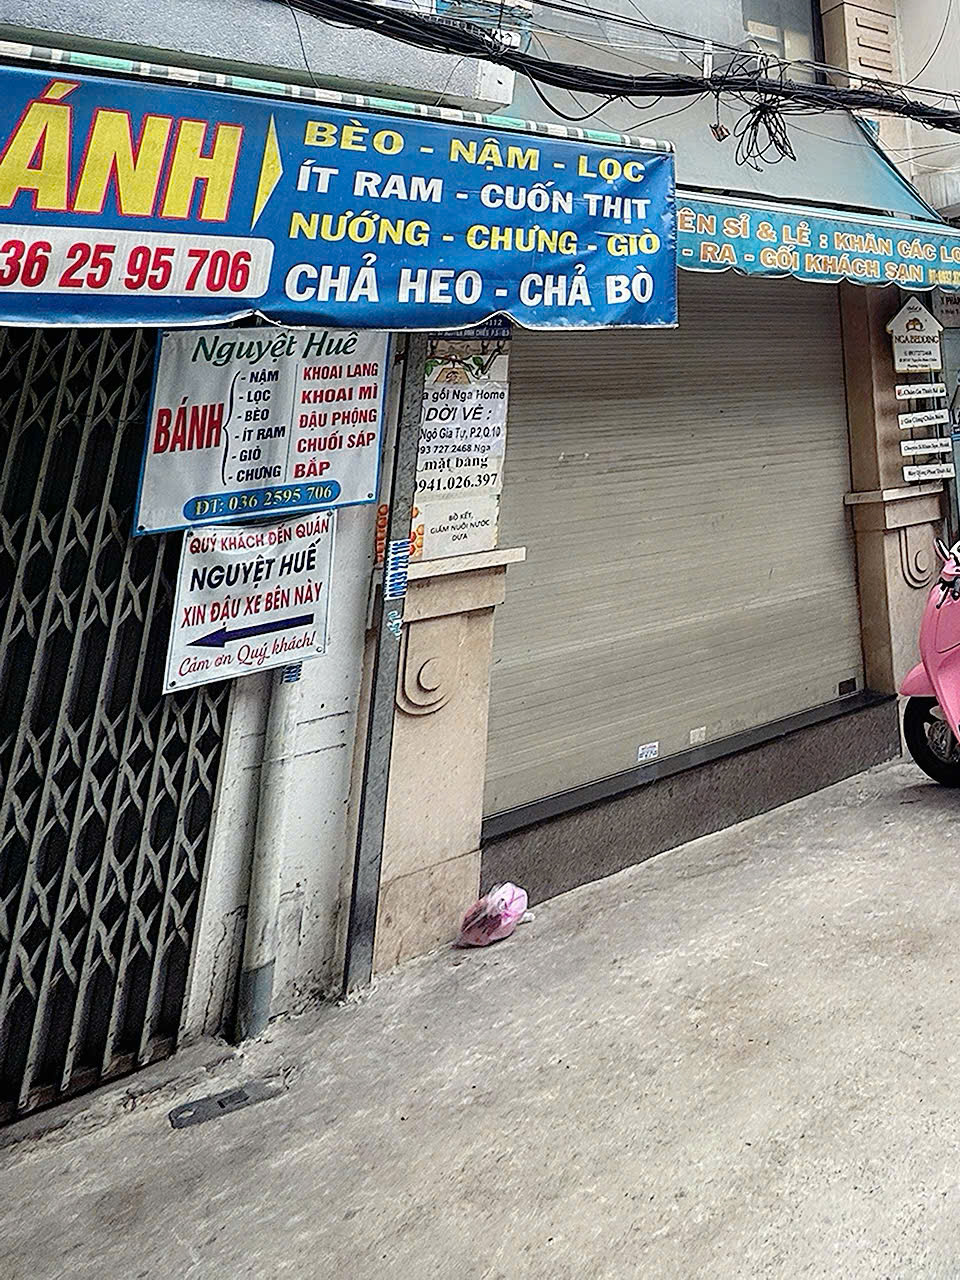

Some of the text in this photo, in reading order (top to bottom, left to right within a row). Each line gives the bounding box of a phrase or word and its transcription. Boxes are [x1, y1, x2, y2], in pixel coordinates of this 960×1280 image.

[0, 80, 245, 223] ÁNH
[303, 119, 405, 155] BÈO
[449, 137, 540, 172] NẬM
[577, 154, 646, 185] LỌC
[296, 159, 339, 193] ÍT
[353, 170, 444, 203] RAM
[480, 182, 573, 214] CUỐN
[583, 193, 651, 224] THỊT
[289, 210, 430, 247] NƯỚNG
[466, 224, 579, 256] CHƯNG
[607, 228, 661, 257] GIÒ
[723, 213, 750, 238] SỈ
[757, 222, 777, 242] &
[783, 221, 811, 247] LẺ
[834, 232, 893, 256] KHĂN
[897, 239, 937, 260] CÁC
[0, 239, 252, 293] 36 25 95 706
[700, 241, 737, 265] RA
[760, 245, 800, 270] GỐI
[805, 252, 880, 279] KHÁCH
[885, 261, 924, 284] SẠN
[285, 252, 380, 303] CHẢ
[398, 268, 483, 306] HEO
[519, 264, 592, 307] CHẢ
[606, 265, 654, 305] BÒ
[191, 333, 298, 367] Nguyệt
[249, 370, 280, 386] NẬM
[303, 363, 379, 381] KHOAI LANG
[246, 389, 271, 405] LỌC
[301, 383, 378, 404] KHOAI MÌ
[452, 389, 473, 403] Nga
[476, 389, 505, 401] Home
[152, 397, 225, 454] BÁNH
[245, 407, 270, 422] BÈO
[299, 408, 377, 431] ĐẬU PHỘNG
[242, 429, 254, 442] ÍT
[256, 426, 286, 441] RAM
[297, 432, 376, 453] CHUỐI SÁP
[434, 445, 448, 454] 727
[451, 444, 472, 453] 2468
[236, 466, 282, 483] CHƯNG
[293, 461, 331, 478] BẮP
[414, 473, 498, 493] 941.026.397
[194, 485, 333, 515] ĐT: 036 2595 706
[189, 516, 330, 555] QUÝ KHÁCH ĐẾN QUÁN
[189, 538, 322, 592] NGUYỆT HUẾ
[181, 578, 323, 628] XIN ĐẬU XE BÊN NÀY
[178, 631, 316, 677] Cảm ơn Quý khách!
